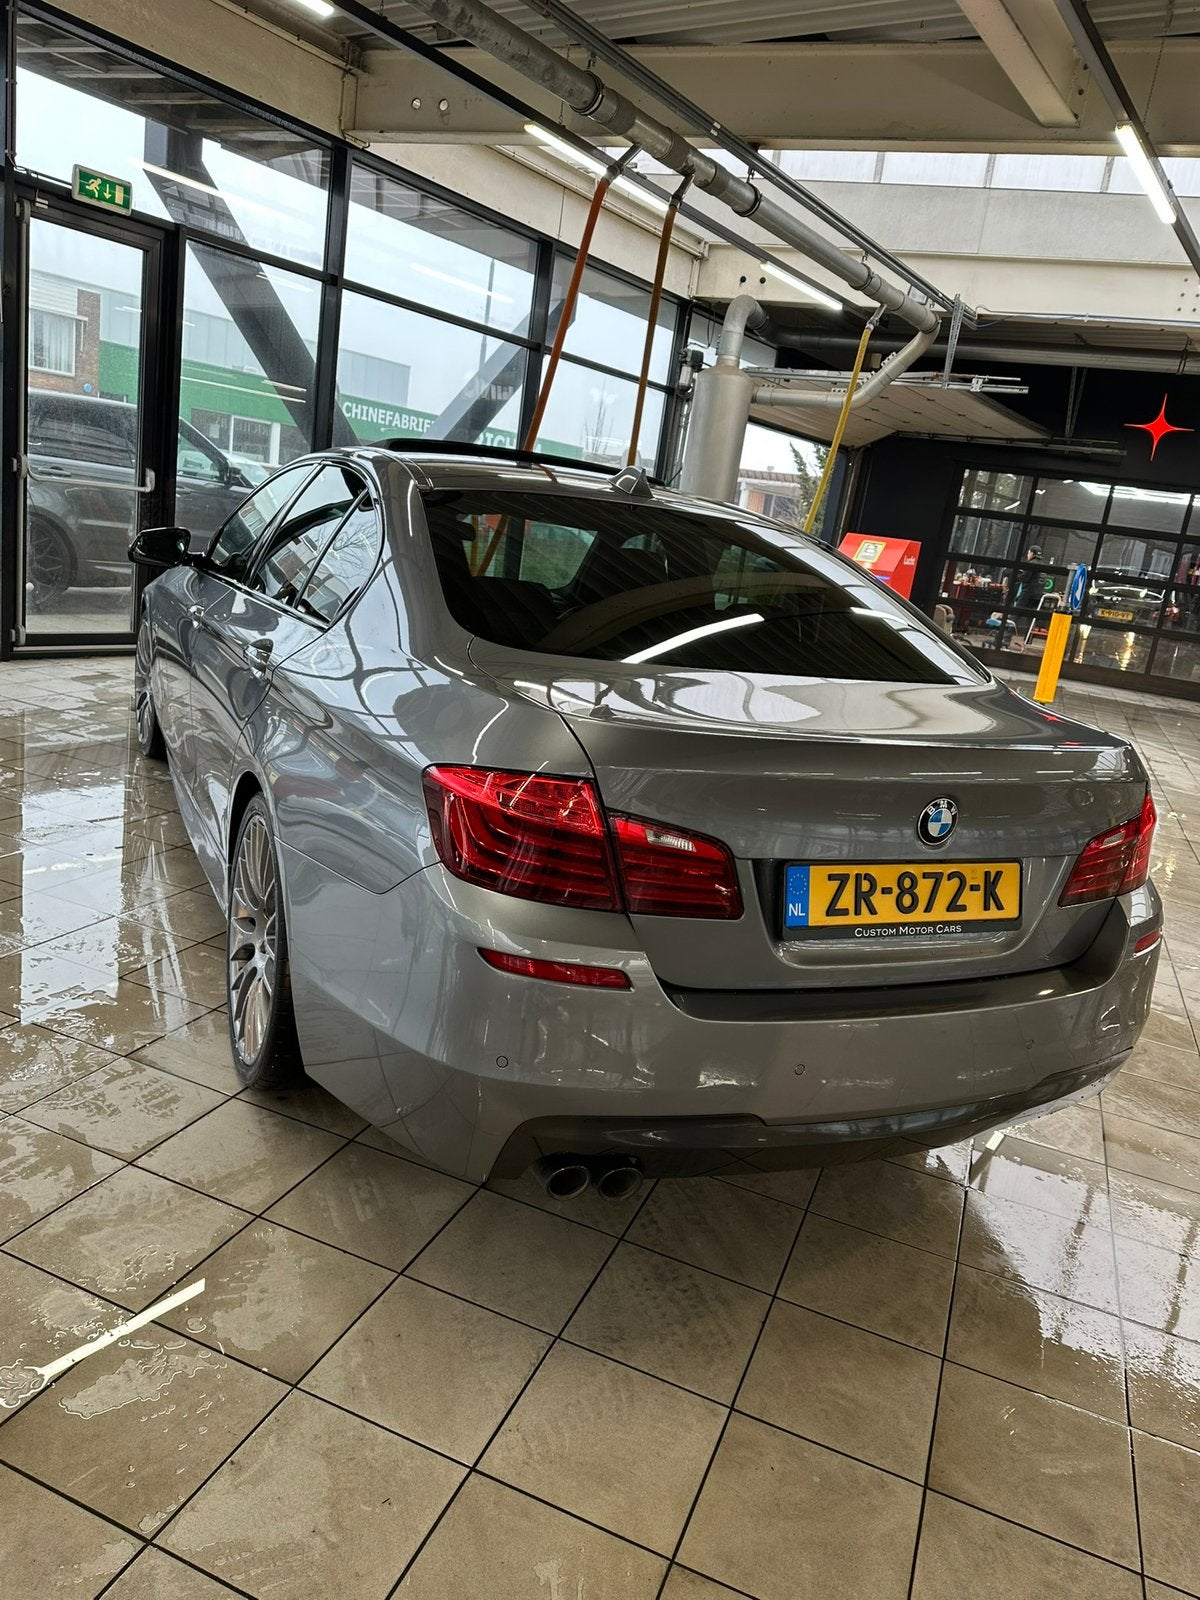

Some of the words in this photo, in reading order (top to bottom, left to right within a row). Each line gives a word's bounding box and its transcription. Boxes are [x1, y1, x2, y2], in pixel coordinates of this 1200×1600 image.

[342, 401, 436, 433] CHINEFABRIE
[926, 800, 957, 815] BMW
[825, 870, 1005, 917] ZR-872-K
[788, 903, 806, 917] NL
